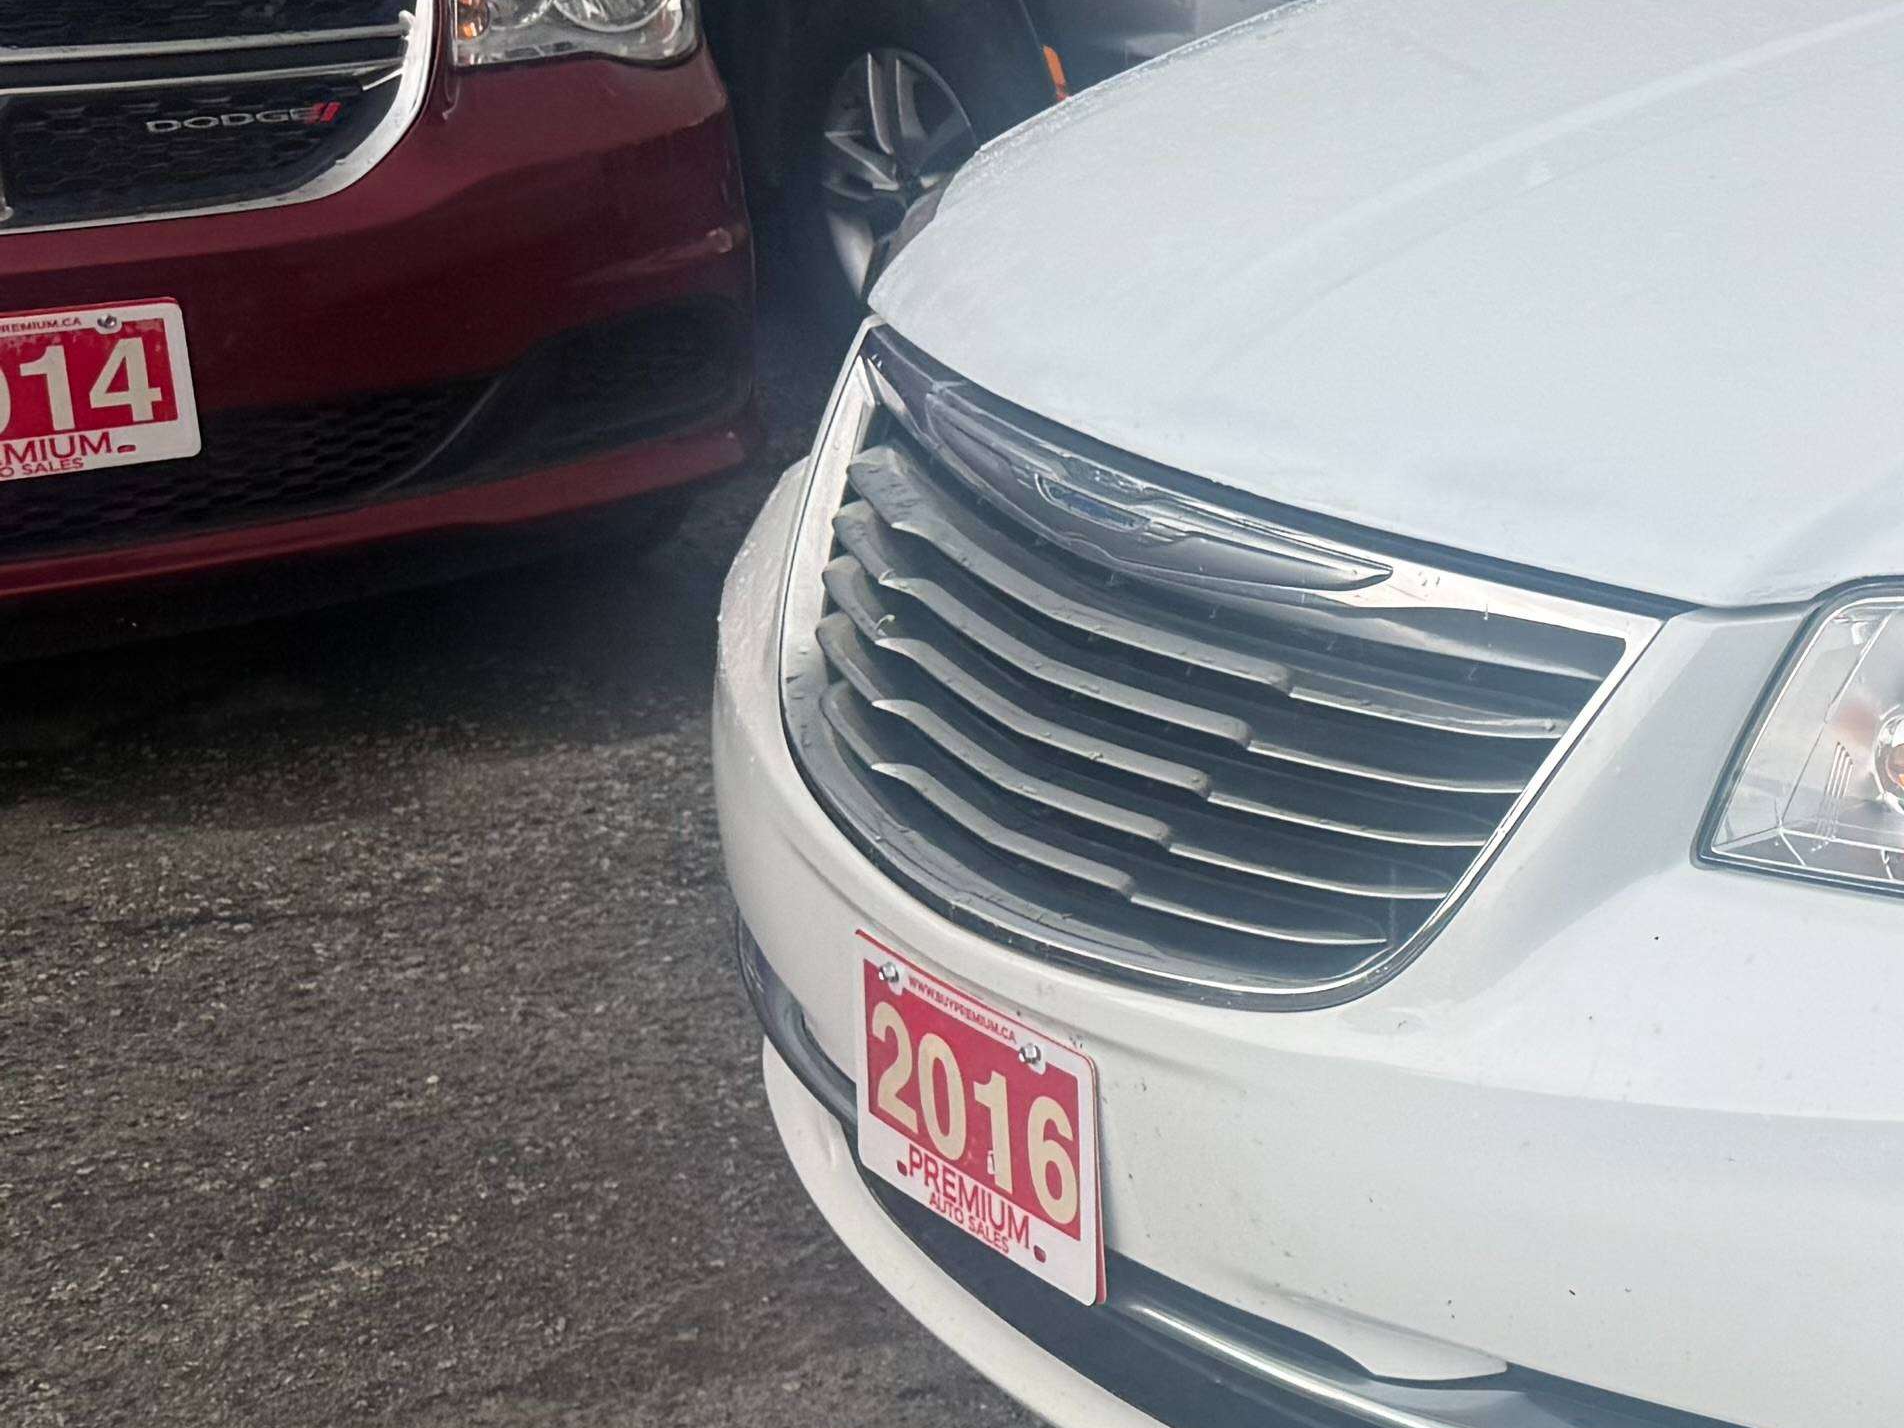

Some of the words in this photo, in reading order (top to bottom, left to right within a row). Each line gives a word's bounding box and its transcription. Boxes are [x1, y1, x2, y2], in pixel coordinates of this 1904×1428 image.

[146, 107, 321, 133] DODGE
[0, 317, 82, 334] REMIUM.CA
[0, 336, 162, 435] 14
[0, 431, 112, 467] MIUM
[22, 457, 84, 475] SALES
[872, 1001, 1078, 1225] 2016
[909, 1144, 1030, 1250] PREMIUM
[929, 1193, 963, 1225] AUTO
[968, 1218, 1010, 1254] SALES
